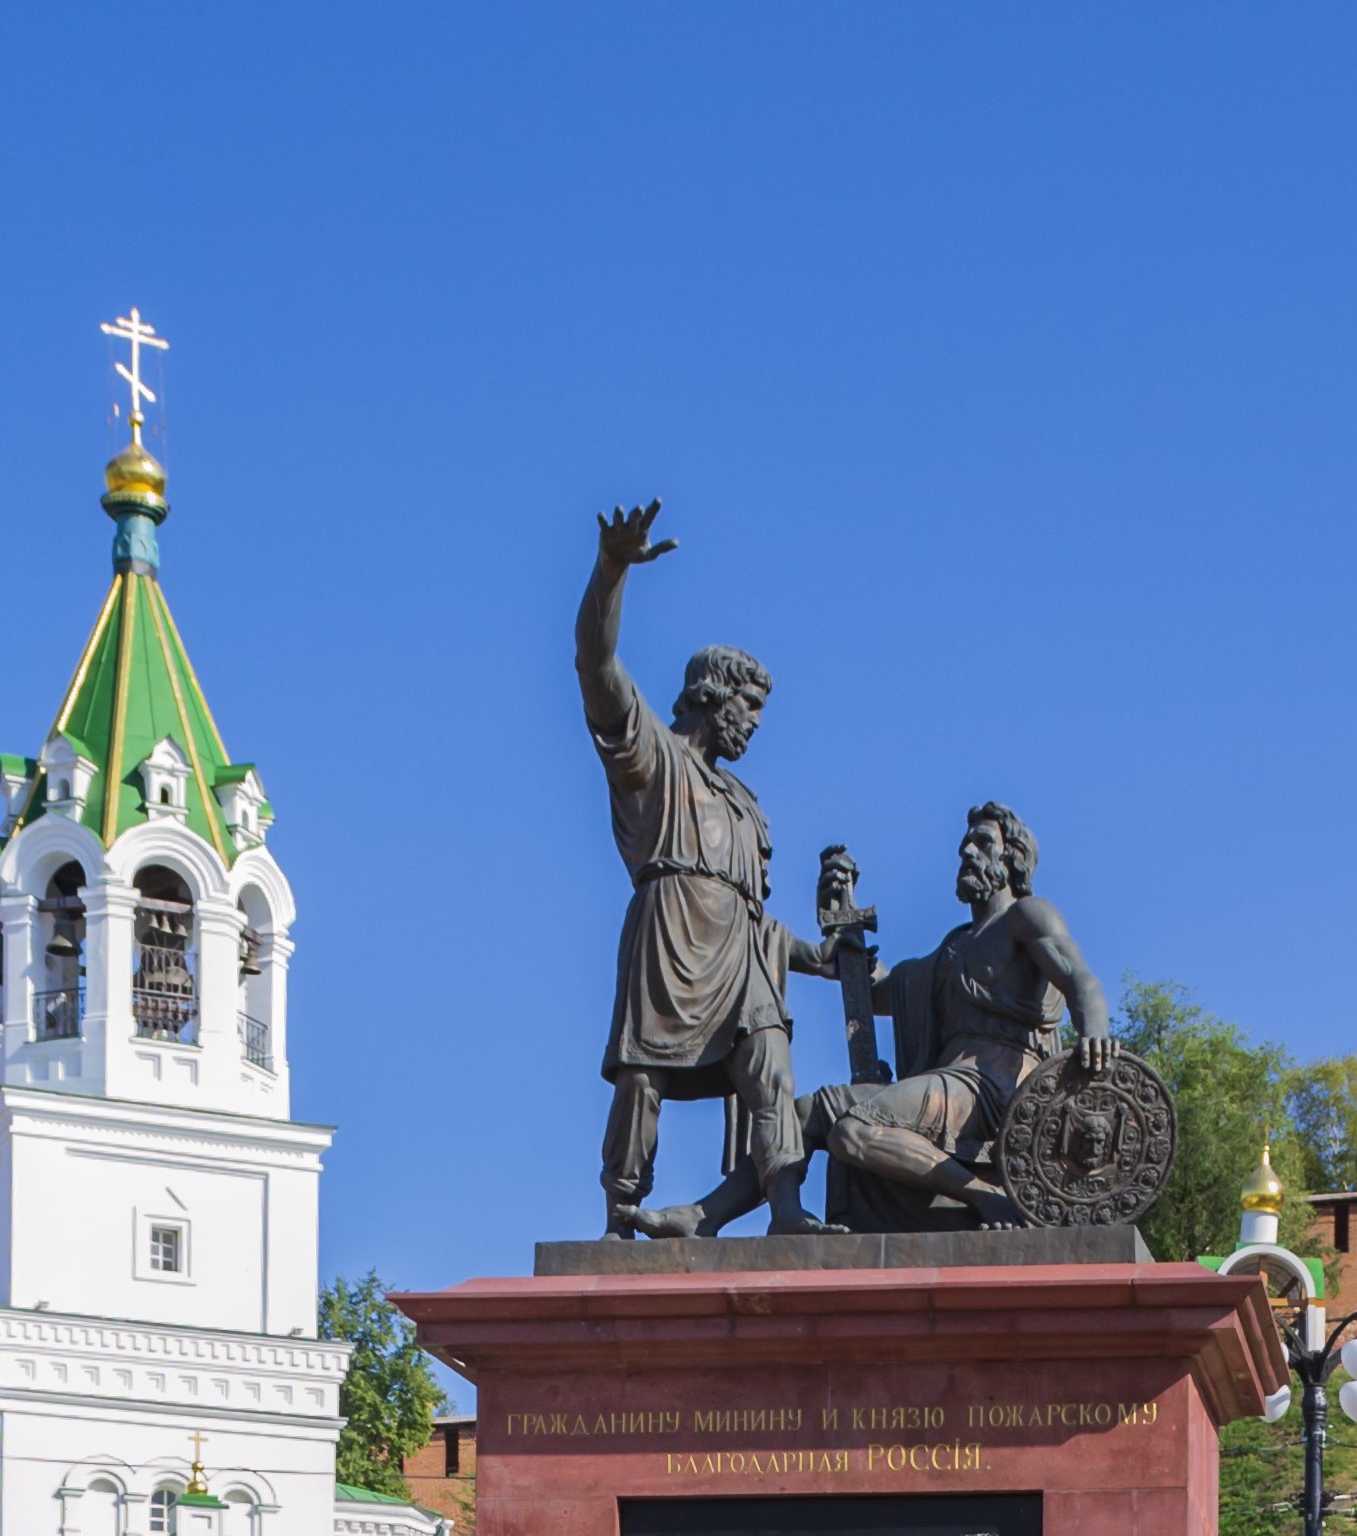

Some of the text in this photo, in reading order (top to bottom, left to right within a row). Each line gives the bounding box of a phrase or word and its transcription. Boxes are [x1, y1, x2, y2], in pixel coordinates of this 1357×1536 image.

[507, 1403, 1158, 1437] ГРАЖДАНИНУ МИНИНУ И КНЯЗЮ ПОЖАРСКОМУ
[667, 1451, 849, 1474] БЛАГОДАРНАЯ
